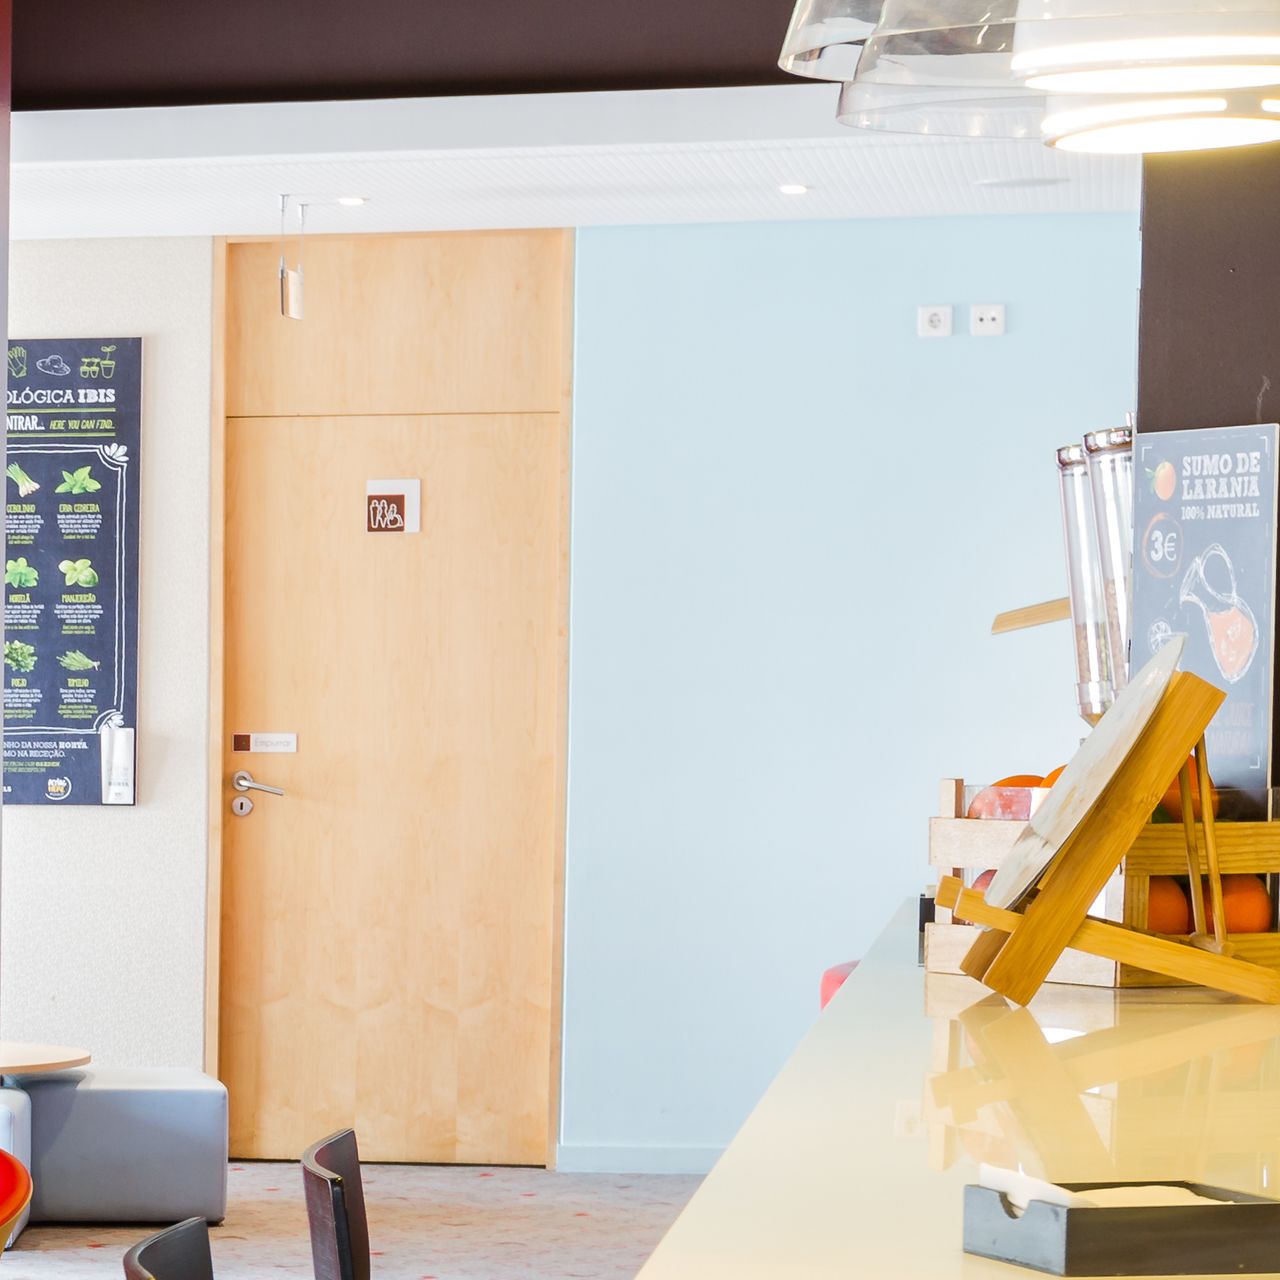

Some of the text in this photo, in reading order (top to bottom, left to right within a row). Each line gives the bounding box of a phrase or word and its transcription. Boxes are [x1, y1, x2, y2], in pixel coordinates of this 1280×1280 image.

[77, 388, 116, 404] IBIS
[1182, 451, 1262, 476] SUMO DE
[1182, 476, 1260, 501] LARANJA
[1181, 503, 1260, 520] 100% NATURAL
[1150, 529, 1177, 562] 3€
